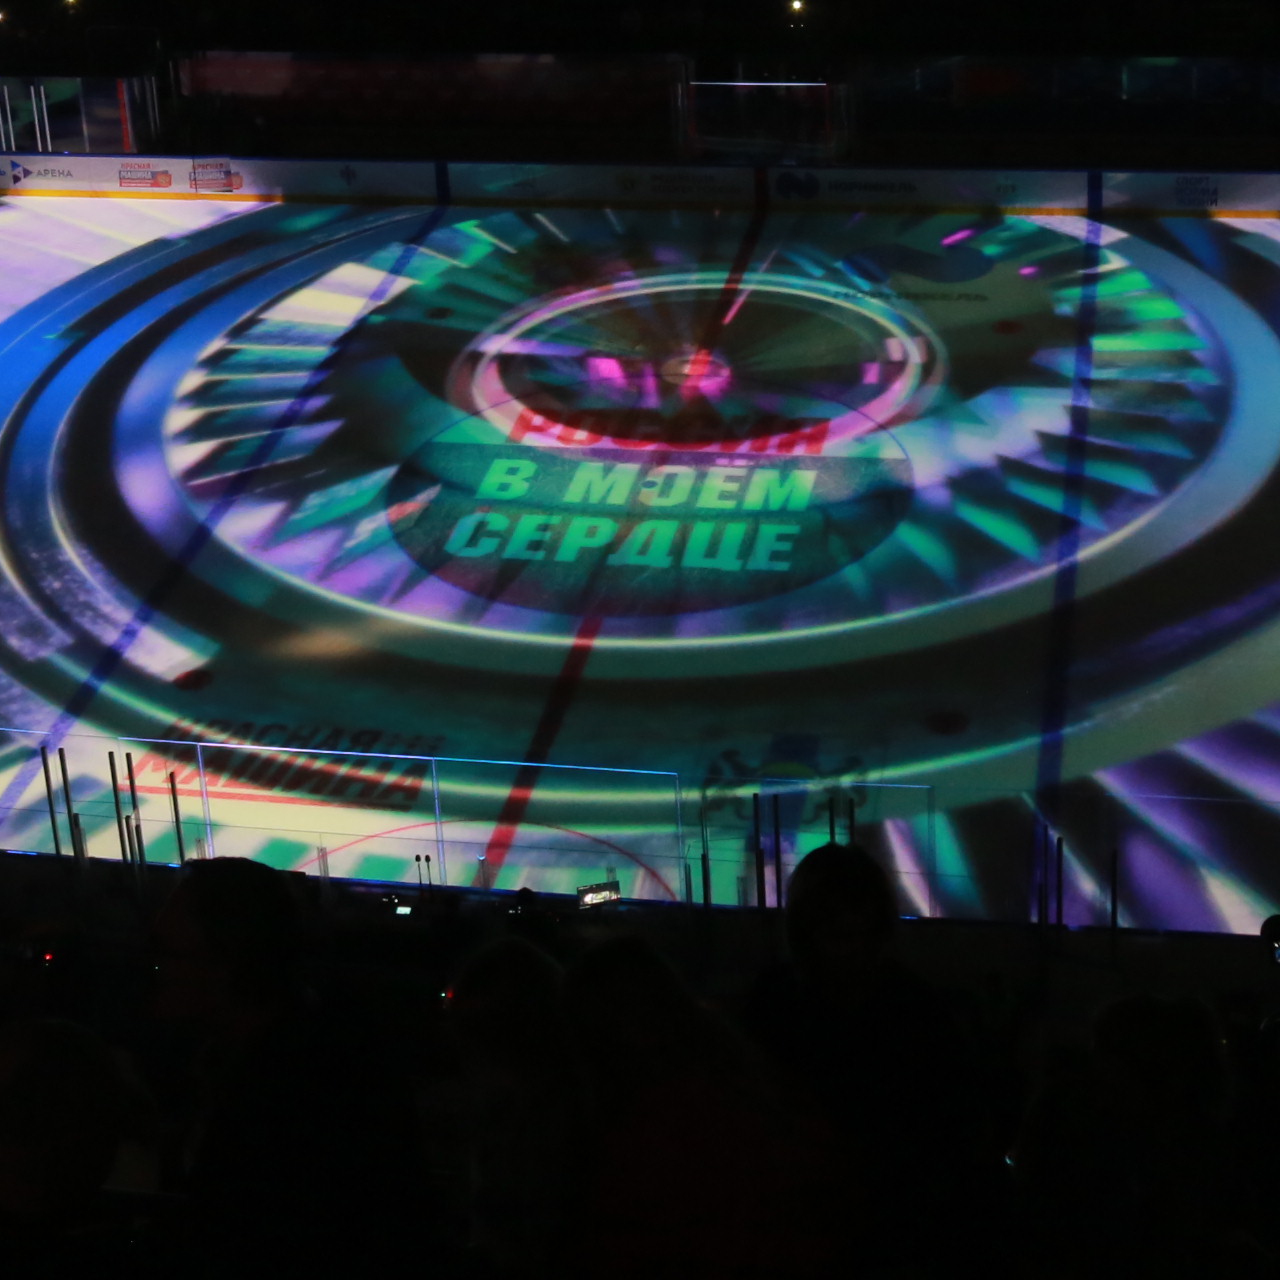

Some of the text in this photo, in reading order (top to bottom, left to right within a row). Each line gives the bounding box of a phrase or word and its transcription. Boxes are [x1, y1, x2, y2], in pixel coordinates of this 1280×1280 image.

[36, 168, 74, 178] АРЕНА
[475, 458, 537, 500] В
[443, 512, 802, 571] СЕРДЦЕ
